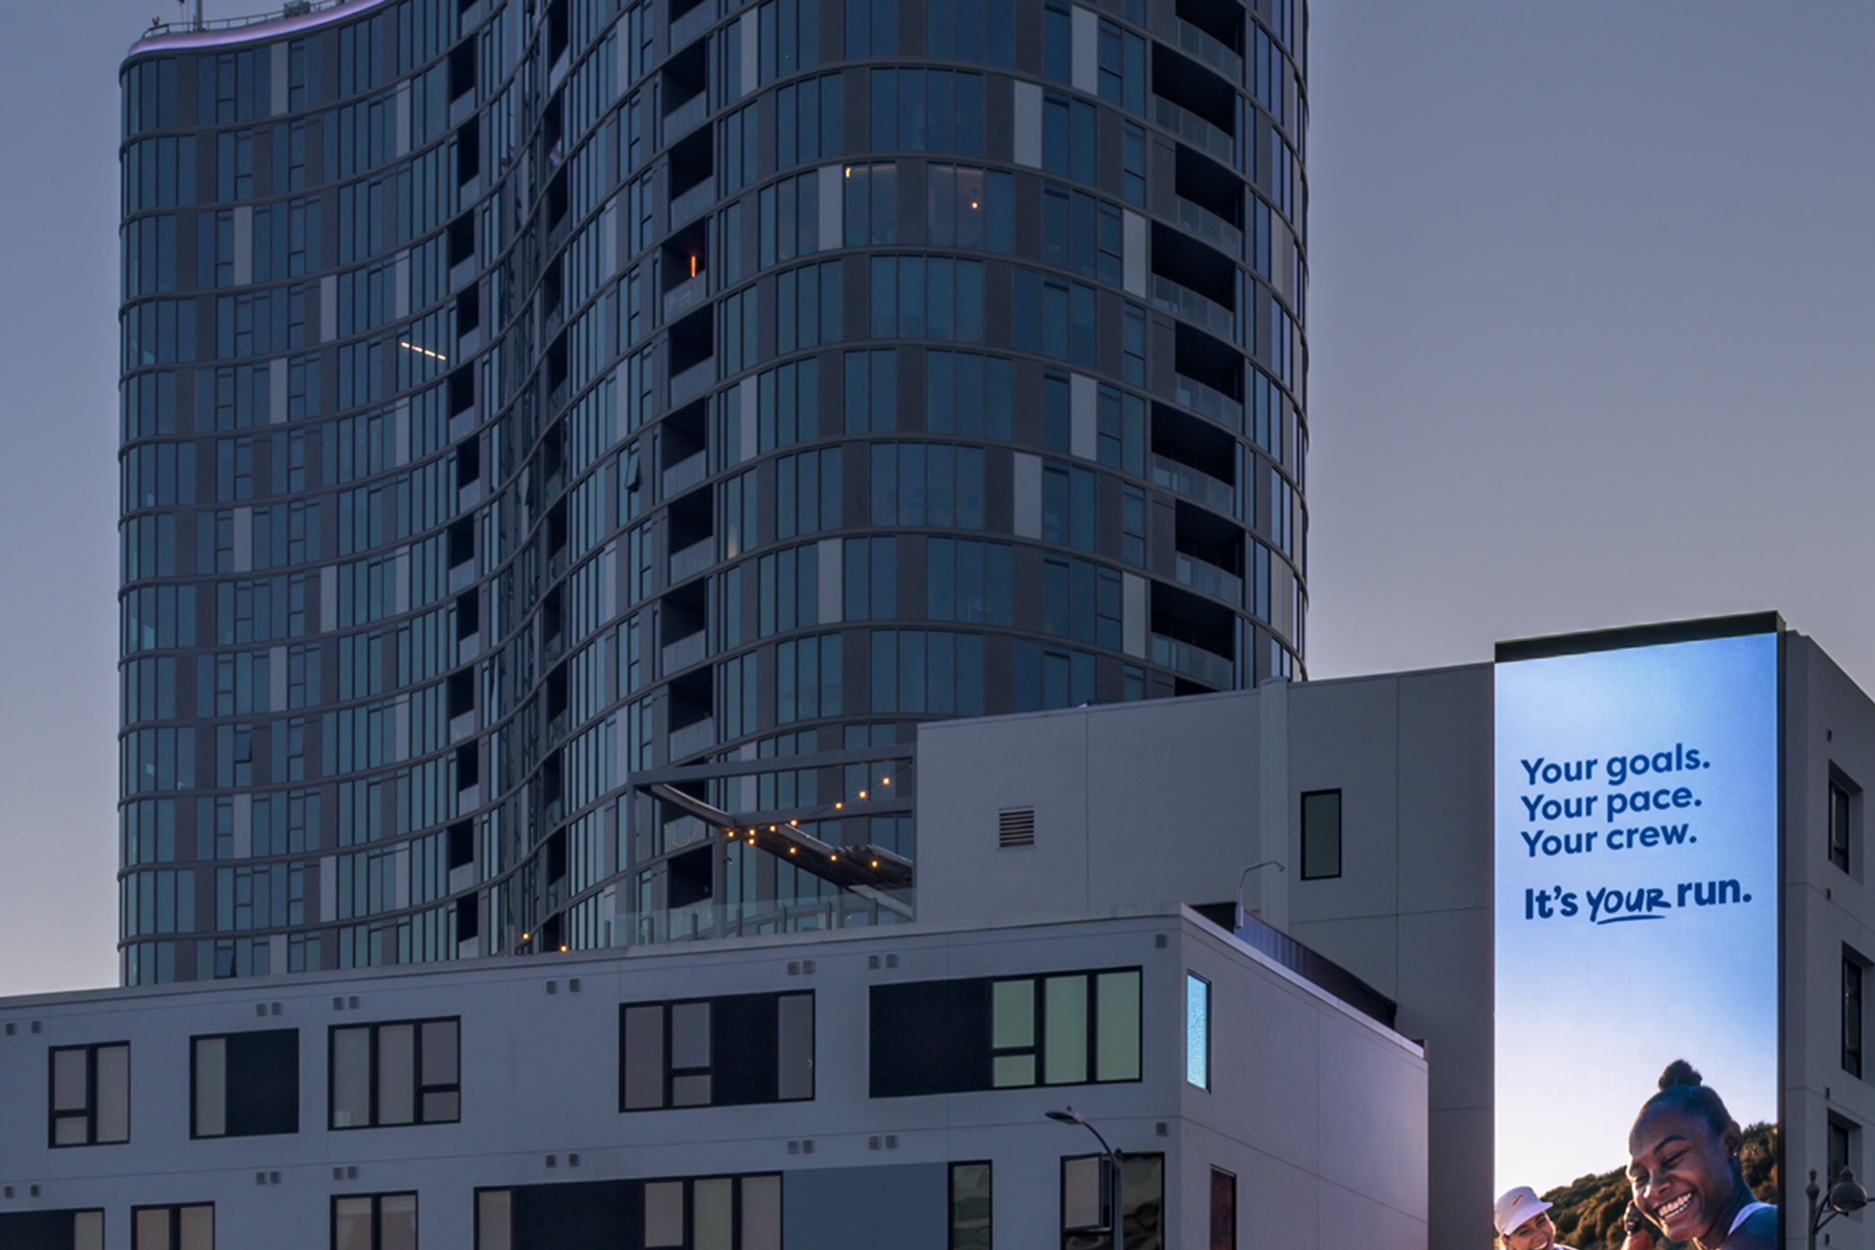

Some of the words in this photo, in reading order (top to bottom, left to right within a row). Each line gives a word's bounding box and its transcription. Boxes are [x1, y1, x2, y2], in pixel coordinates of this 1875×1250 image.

[1520, 757, 1598, 786] Your
[1605, 743, 1711, 786] goals.
[1520, 793, 1598, 822] Your
[1606, 787, 1703, 823] pace.
[1520, 830, 1598, 857] Your
[1605, 823, 1698, 850] crew.
[1524, 885, 1579, 920] It's
[1585, 887, 1672, 923] YOUR
[1676, 878, 1753, 908] run.
